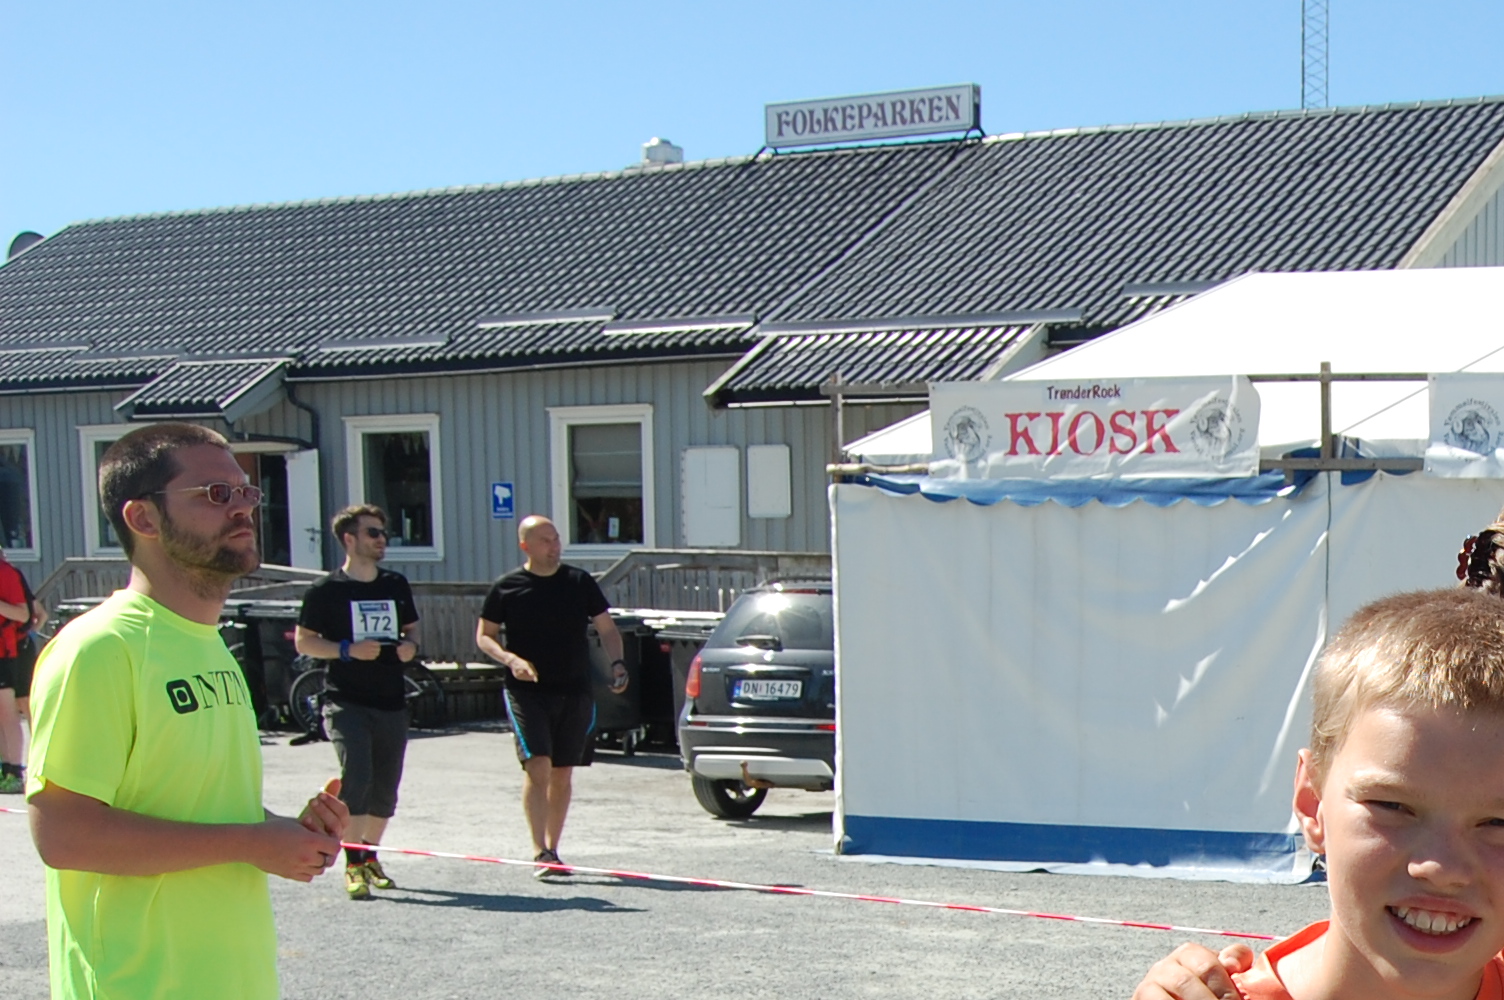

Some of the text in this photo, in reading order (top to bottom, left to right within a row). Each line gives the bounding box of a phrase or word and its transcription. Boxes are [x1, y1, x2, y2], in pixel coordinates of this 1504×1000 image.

[776, 94, 962, 137] FOLKEPARKEN
[1047, 384, 1121, 400] TrønderRock
[1004, 409, 1181, 456] KIOSK
[361, 614, 391, 633] 172
[743, 683, 799, 695] DN 16479
